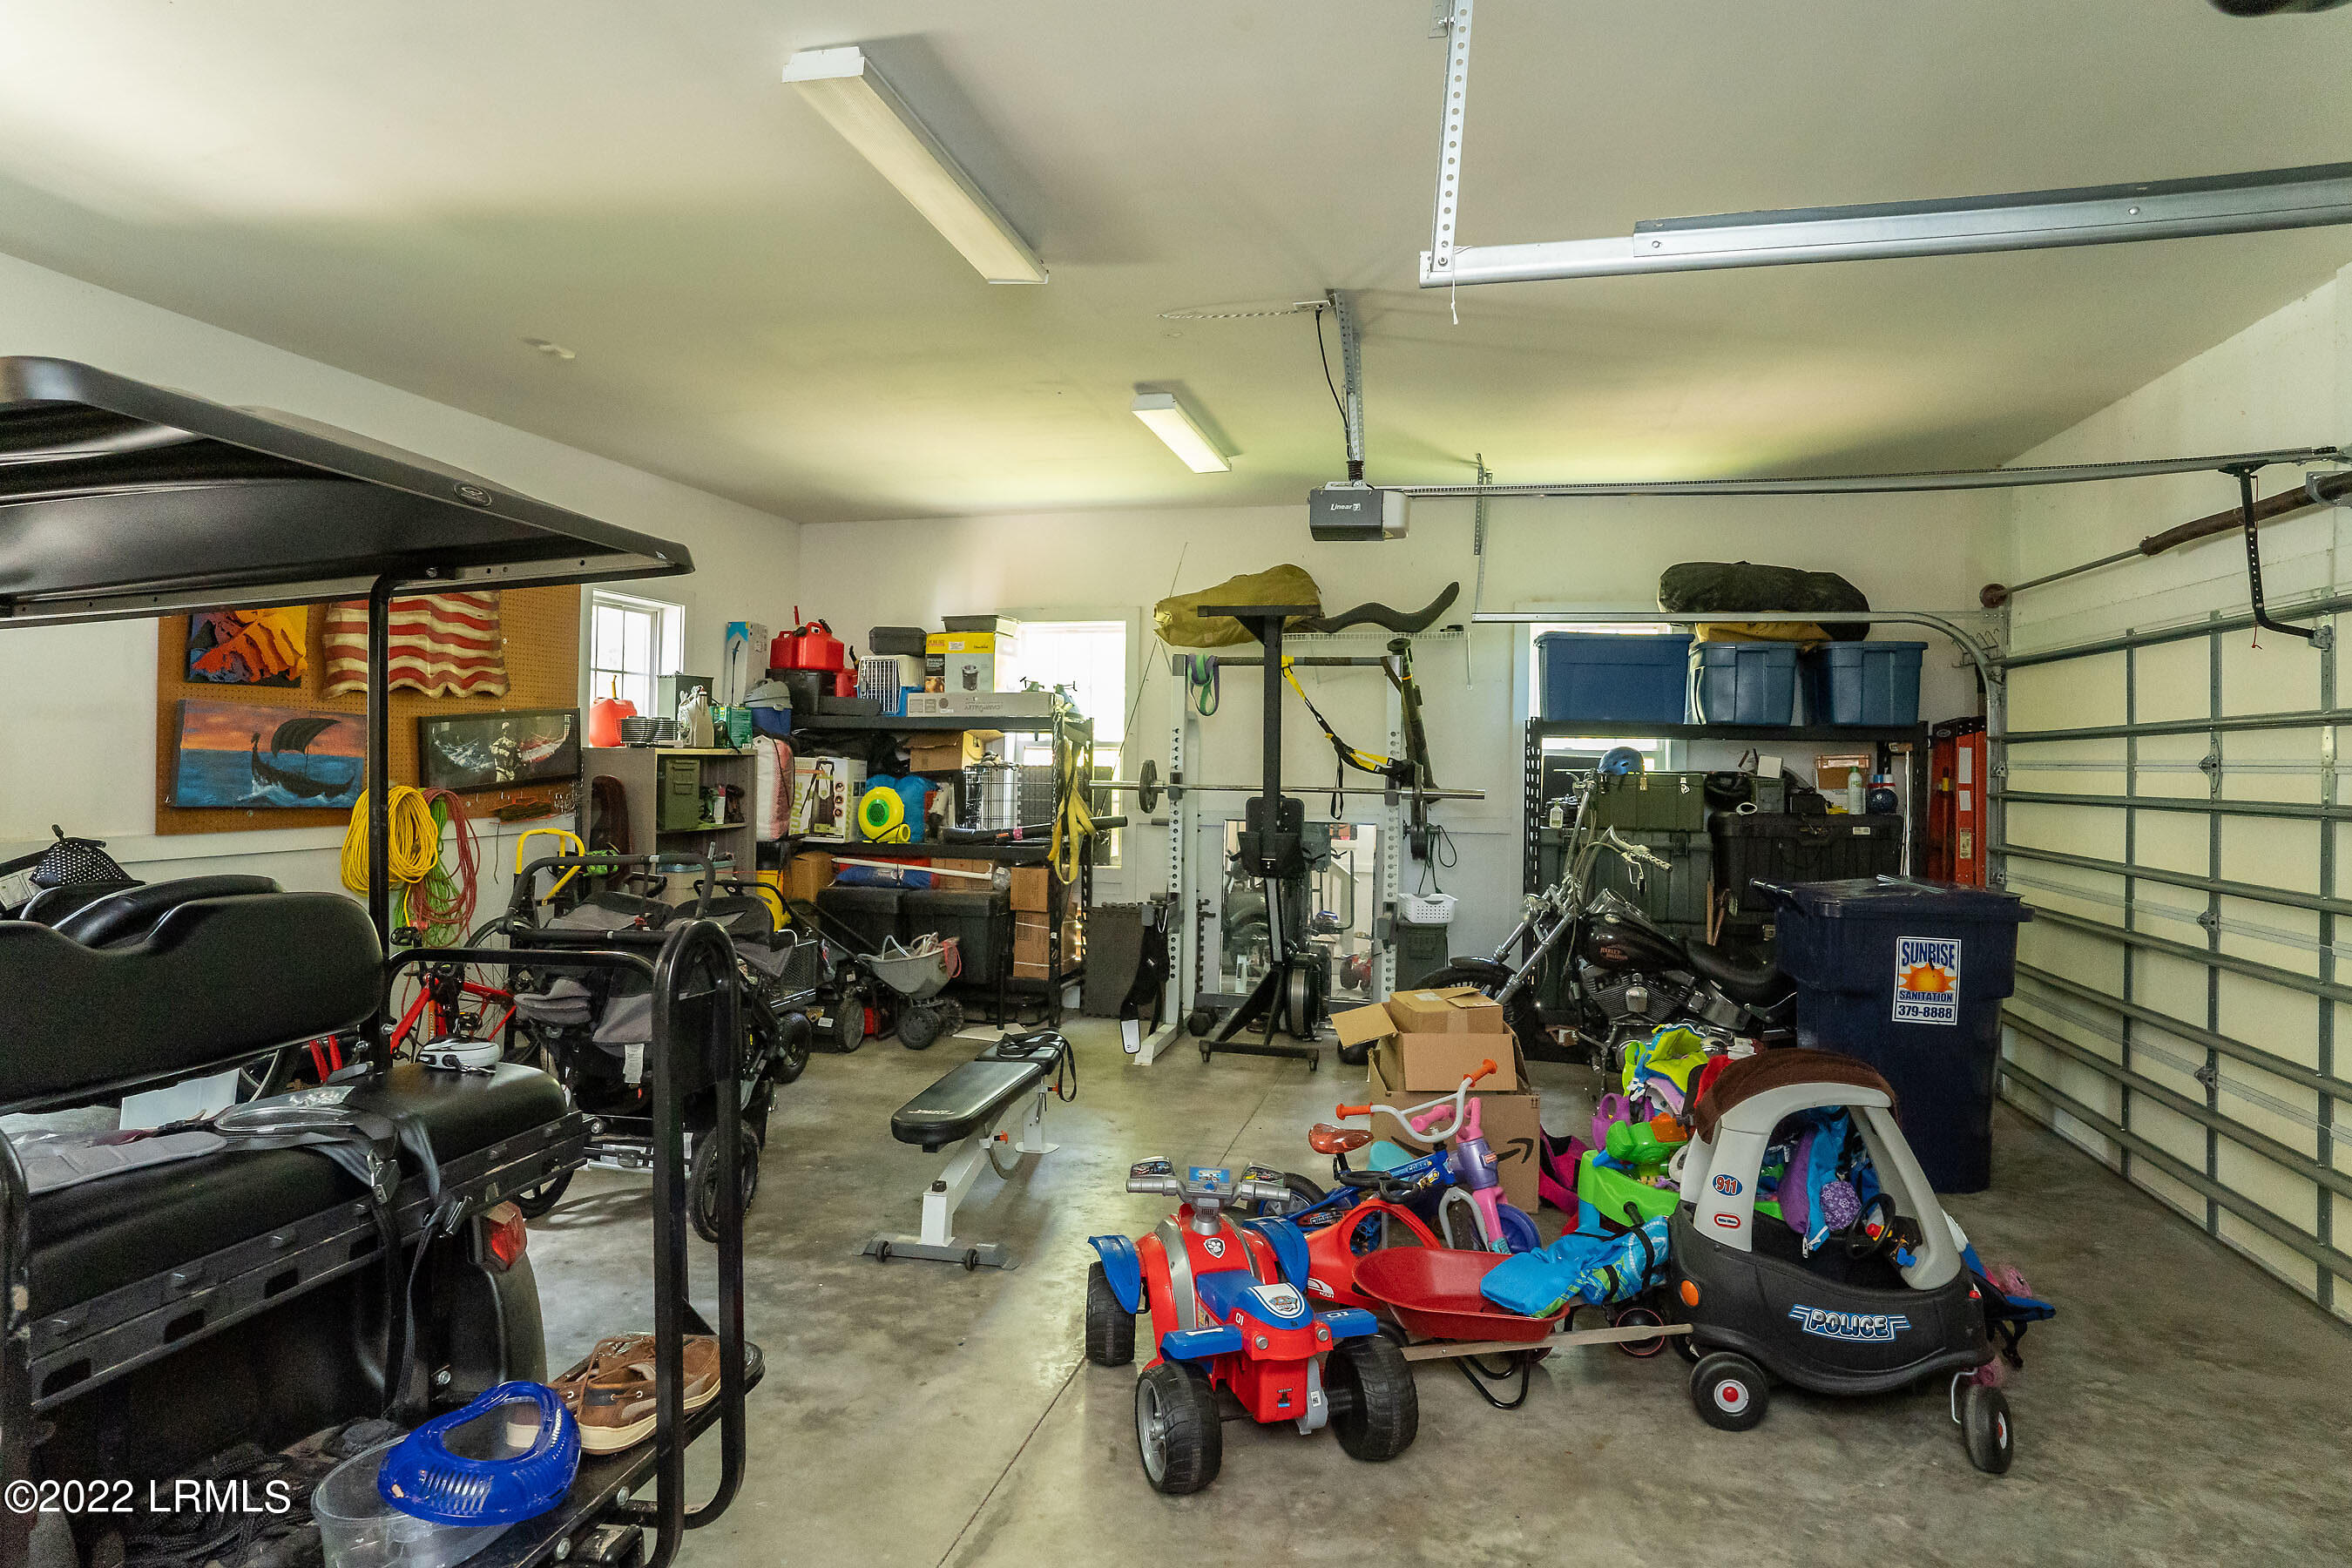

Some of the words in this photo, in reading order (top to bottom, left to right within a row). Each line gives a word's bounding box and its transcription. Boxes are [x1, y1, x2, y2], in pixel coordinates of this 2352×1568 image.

[1902, 941, 1955, 970] SUNRISE
[1899, 990, 1953, 1003] SANITATION
[1897, 1004, 1953, 1019] 379-8888
[1716, 1175, 1738, 1195] 911
[1234, 1312, 1245, 1326] 01
[1808, 1308, 1889, 1339] POLICE
